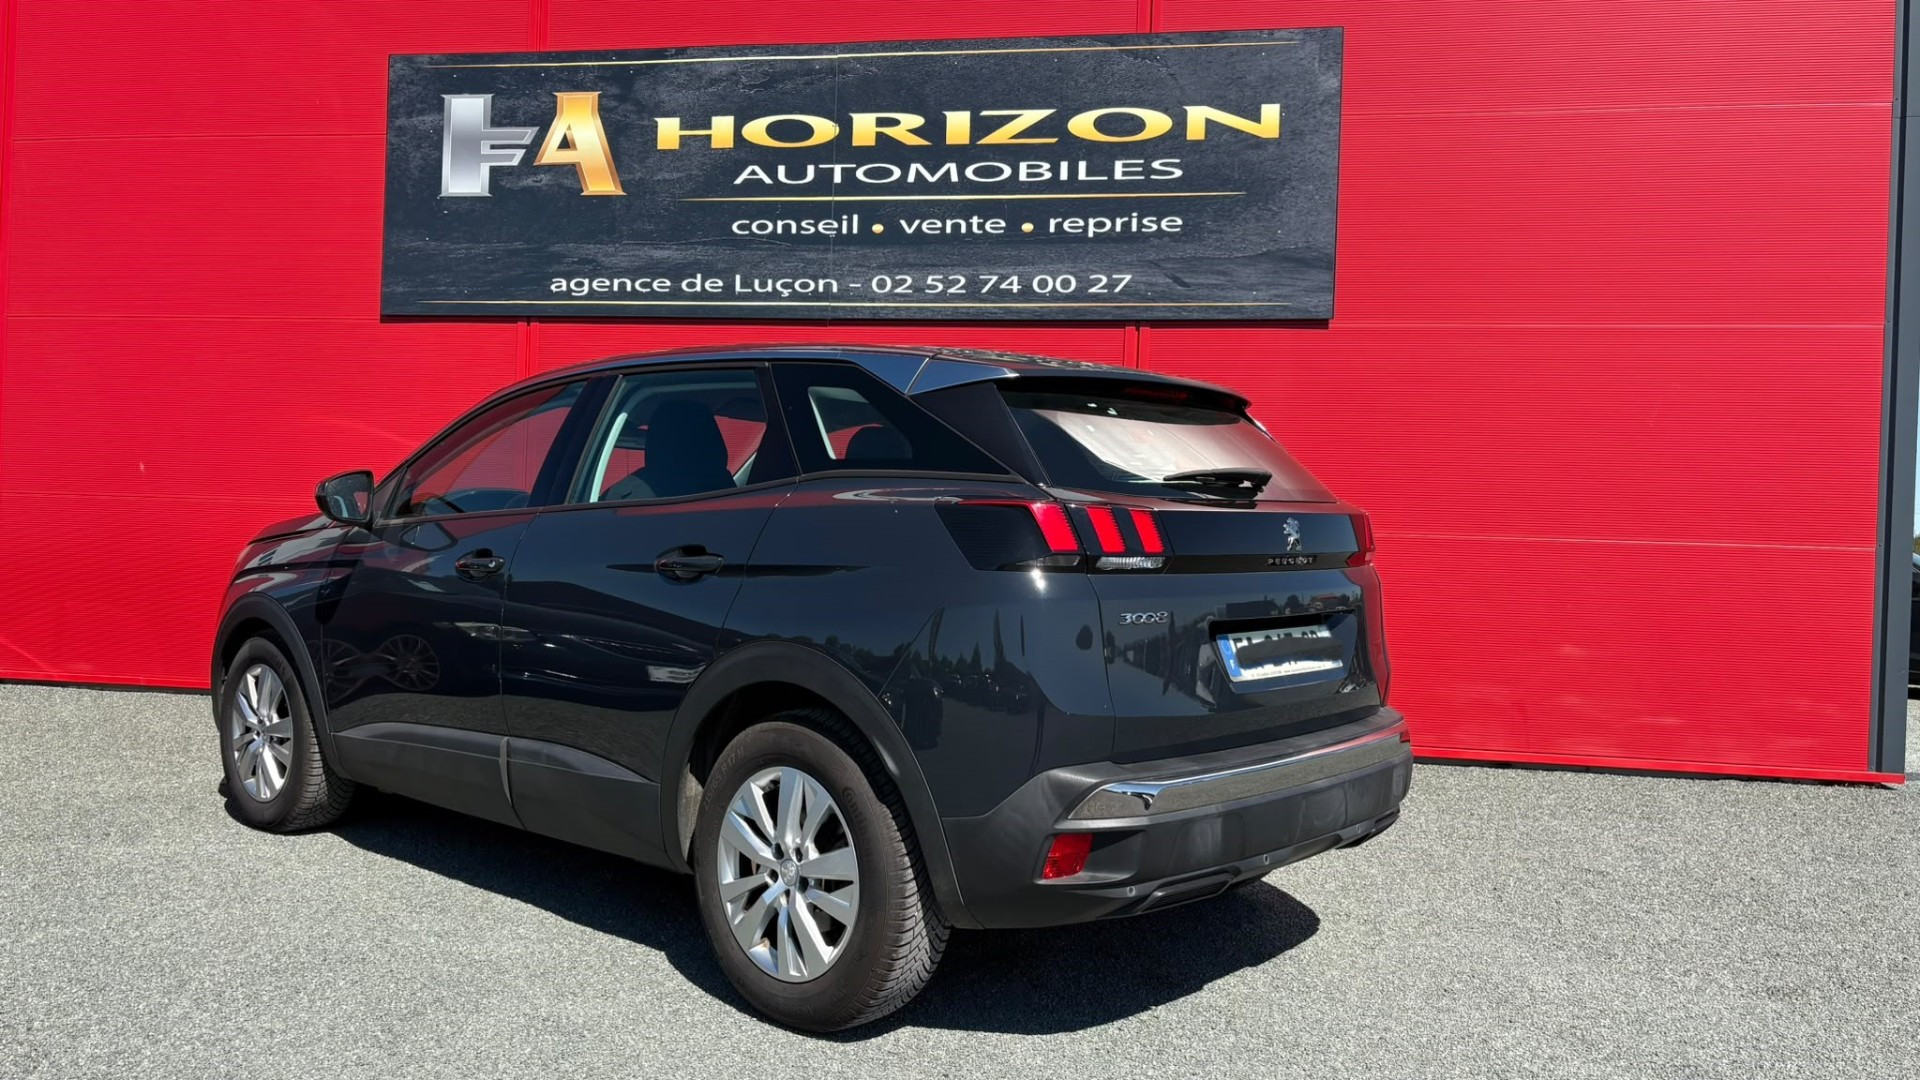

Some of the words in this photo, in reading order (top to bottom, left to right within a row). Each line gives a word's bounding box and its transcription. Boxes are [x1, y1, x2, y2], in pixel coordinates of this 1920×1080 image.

[654, 103, 1281, 150] HORIZON
[733, 158, 1184, 185] AUTOMOBILES
[731, 214, 859, 235] conseil
[899, 216, 1007, 234] vente
[1048, 212, 1183, 238] reprise
[550, 277, 672, 296] agence
[681, 273, 724, 293] de
[734, 274, 838, 297] Luçon
[871, 275, 913, 294] 02
[924, 275, 967, 294] 52
[978, 275, 1022, 294] 74
[1032, 275, 1077, 294] 00
[1087, 274, 1133, 293] 27
[1267, 556, 1314, 566] PEUGEOT
[1119, 611, 1168, 625] 3008
